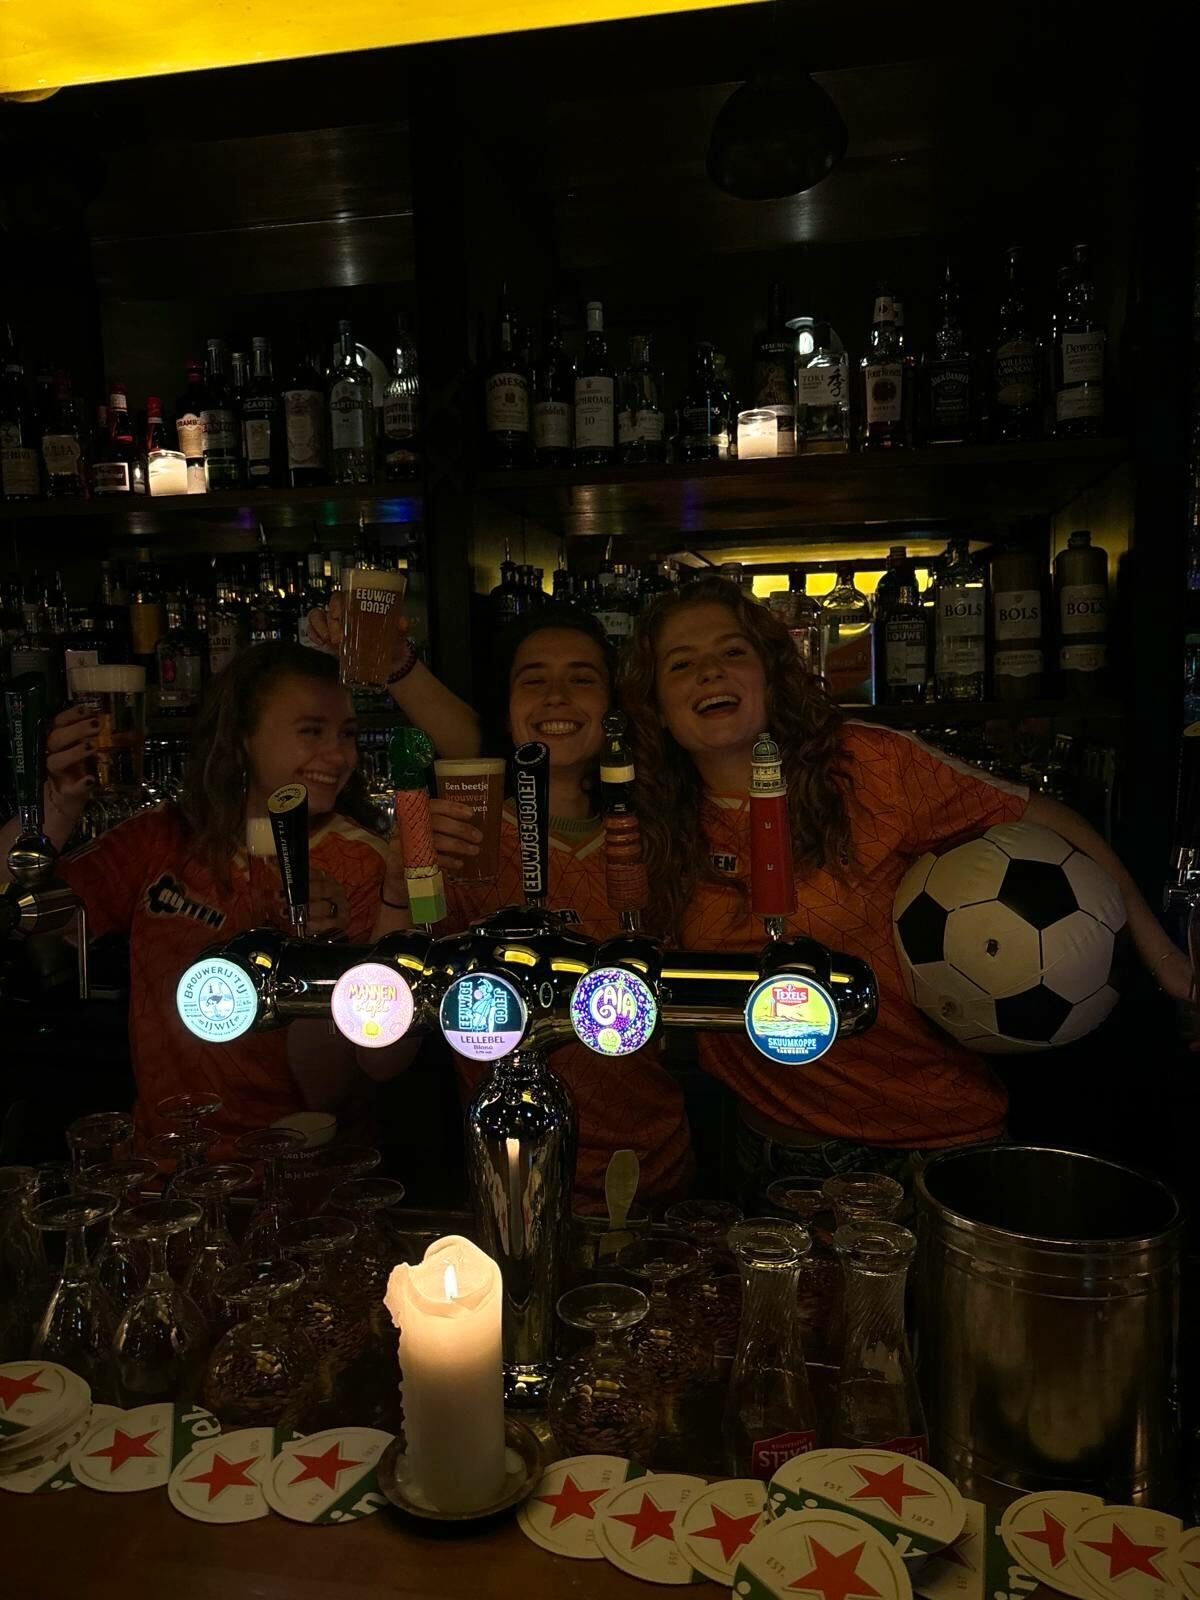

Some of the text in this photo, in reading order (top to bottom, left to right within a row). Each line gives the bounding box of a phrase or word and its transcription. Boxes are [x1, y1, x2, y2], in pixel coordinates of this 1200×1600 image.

[360, 600, 390, 615] JEUGD
[944, 603, 982, 617] BOLS
[999, 607, 1039, 621] BOLS
[1066, 602, 1105, 616] BOLS
[445, 781, 488, 791] Een beetje
[184, 966, 233, 999] BROUWERIJ
[349, 983, 397, 1001] MANNEN
[773, 988, 807, 1001] TEXELS
[494, 987, 508, 1024] JEUGD
[460, 1035, 506, 1044] LELLEBEL
[767, 1037, 817, 1048] SKUUMKOPPE
